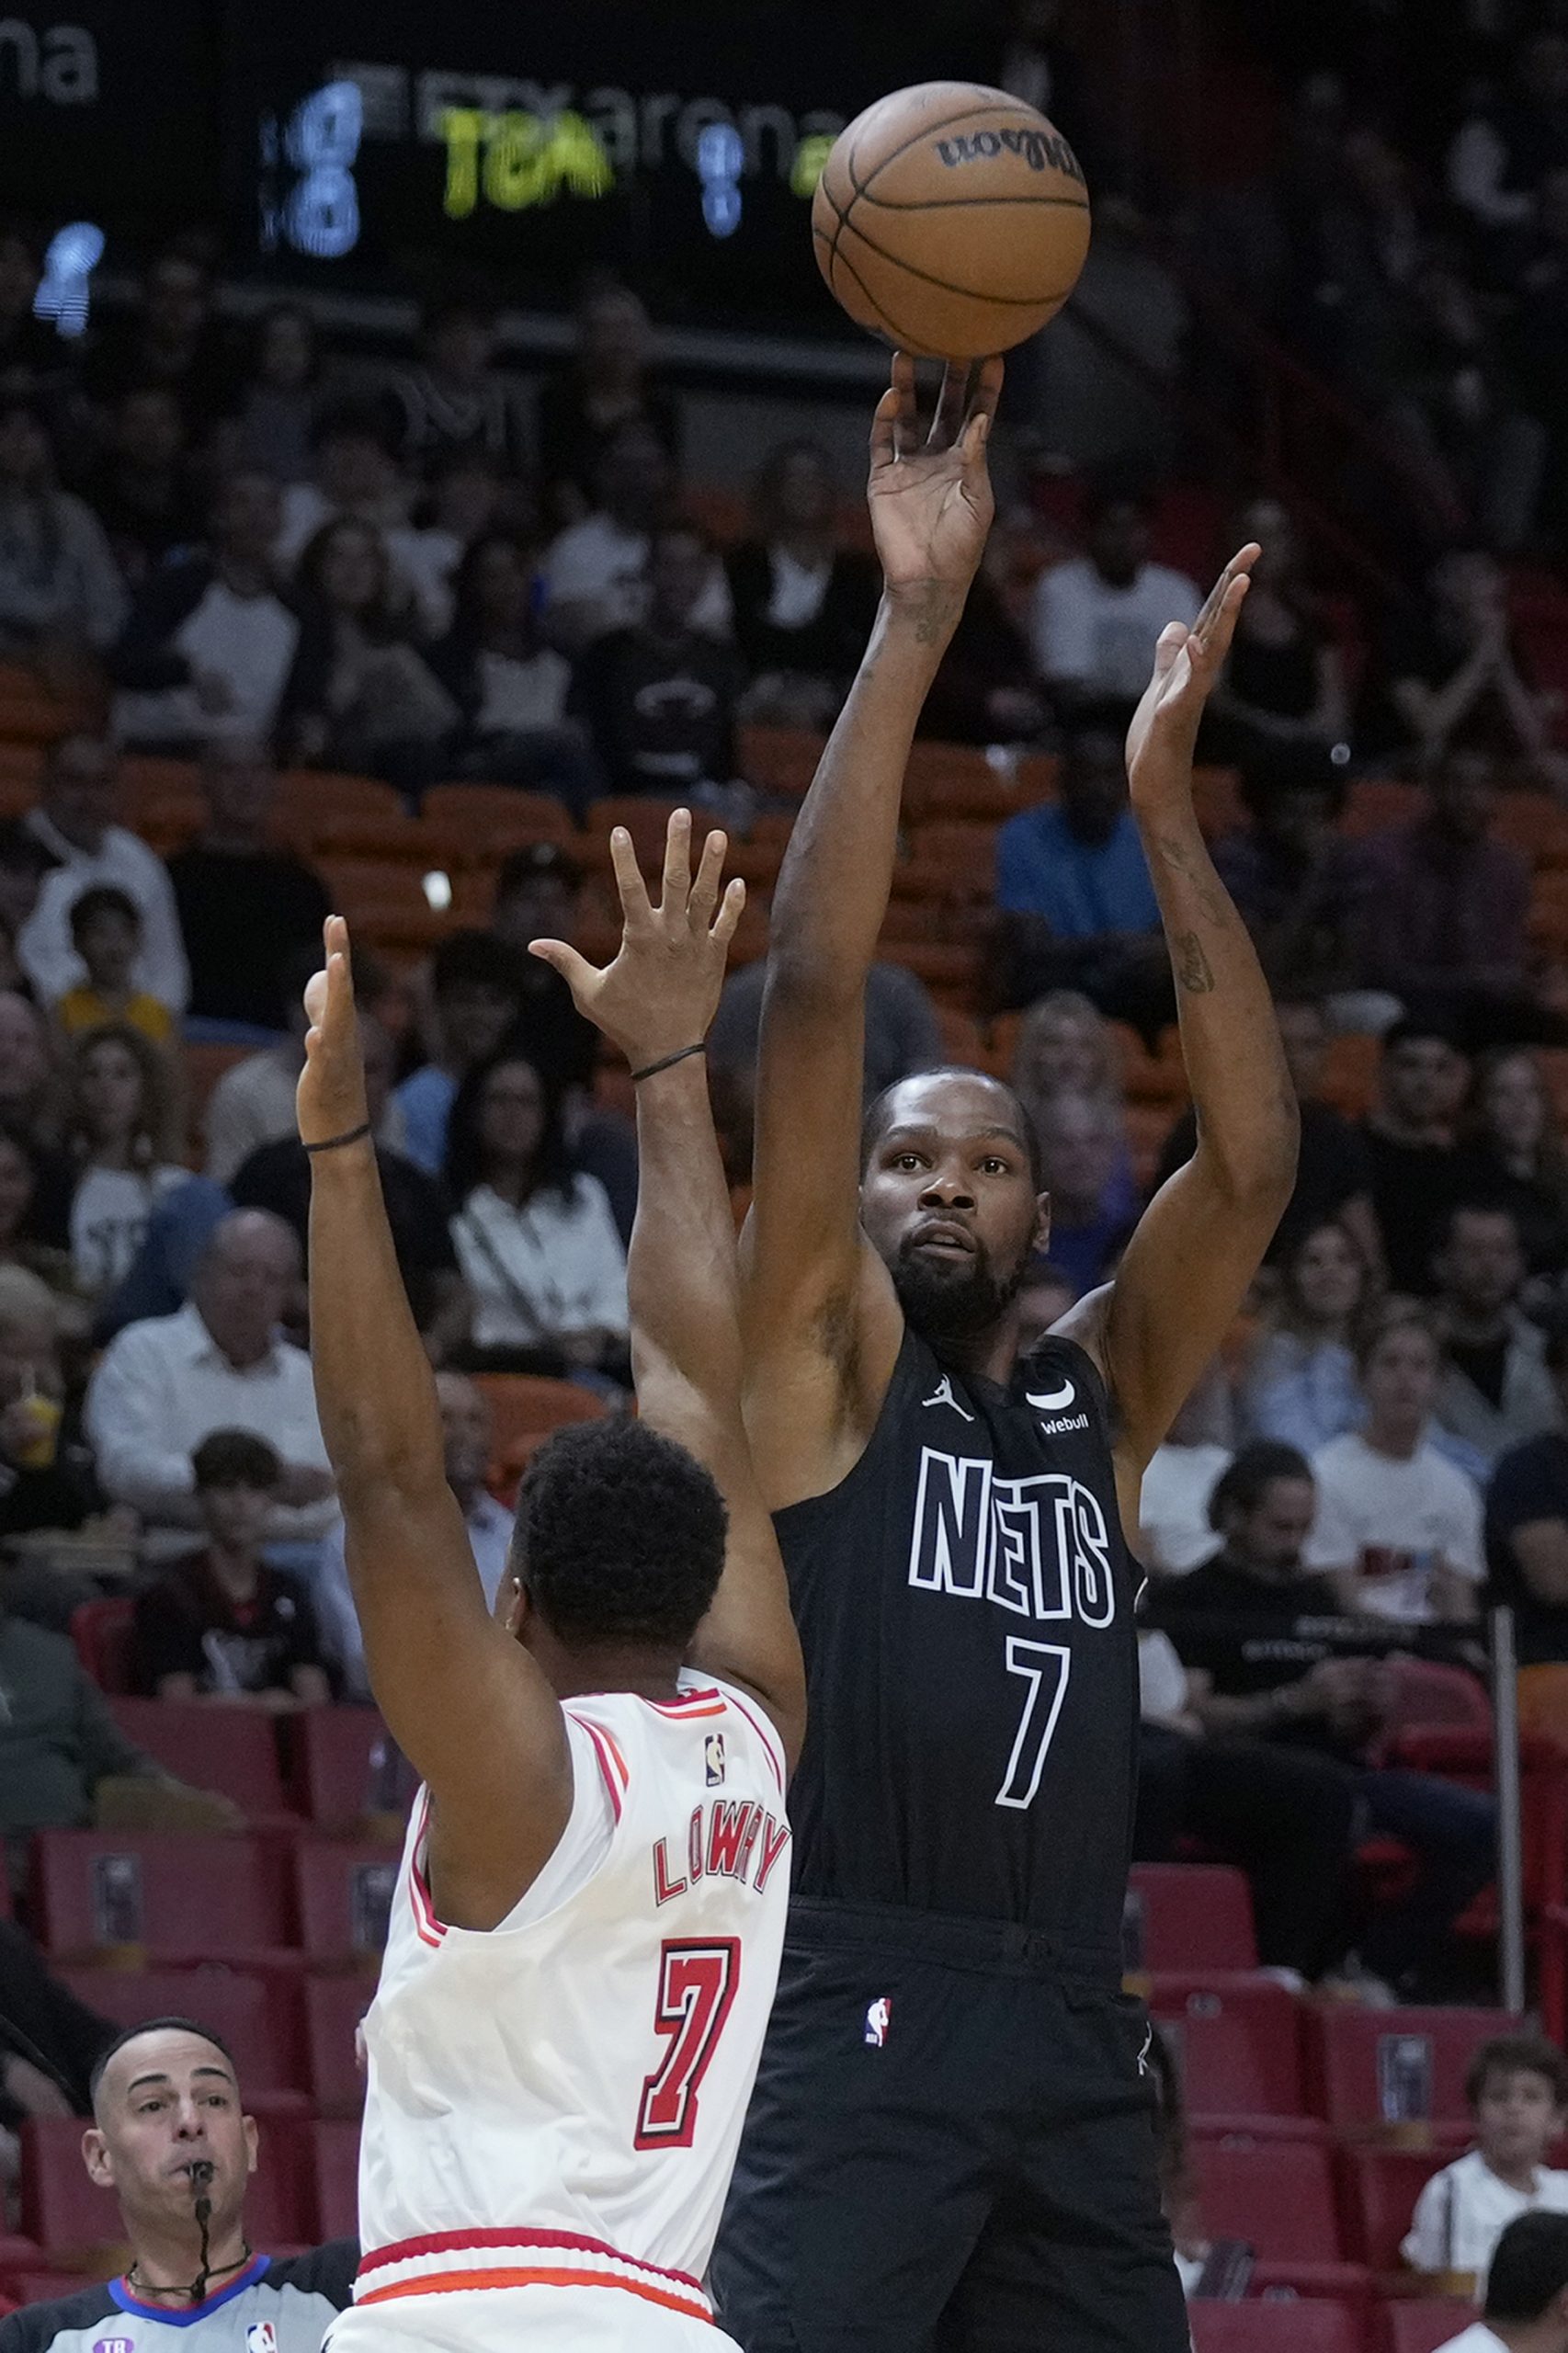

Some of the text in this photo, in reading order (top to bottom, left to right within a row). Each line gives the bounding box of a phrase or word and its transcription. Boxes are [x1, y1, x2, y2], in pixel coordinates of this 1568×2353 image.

[1040, 1413, 1089, 1435] Webull
[908, 1445, 1115, 1629] NETS
[994, 1635, 1071, 1810] 7
[633, 1936, 742, 2151] 7
